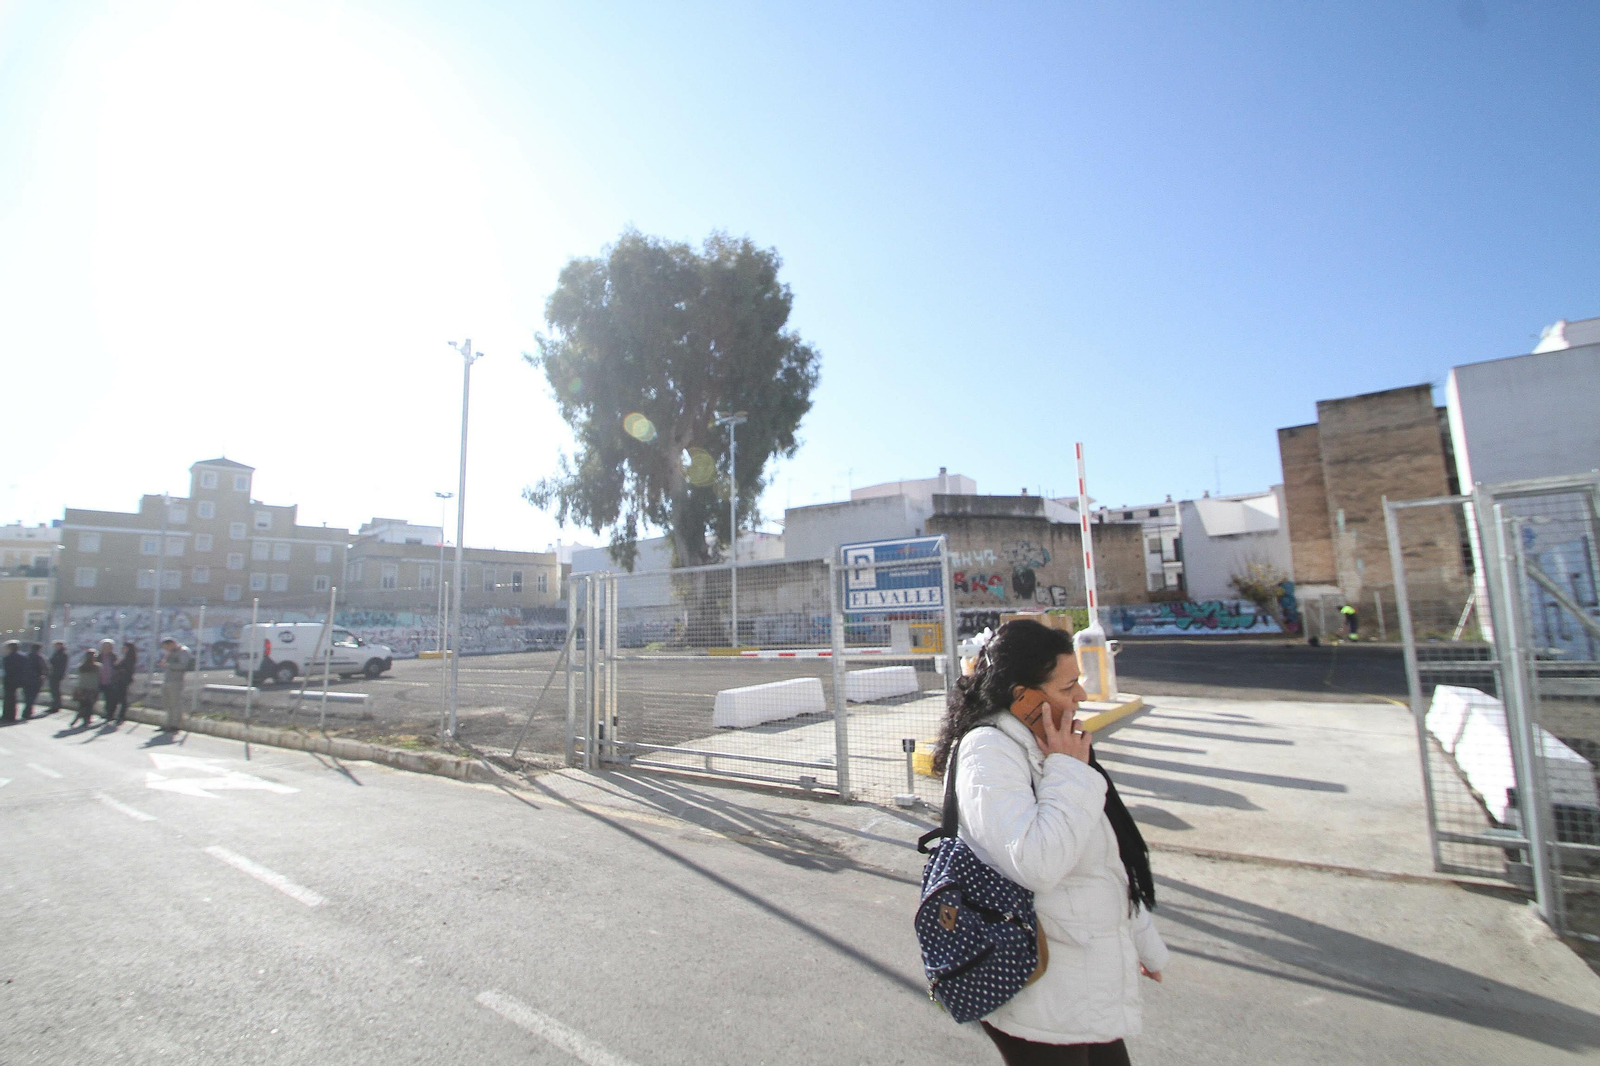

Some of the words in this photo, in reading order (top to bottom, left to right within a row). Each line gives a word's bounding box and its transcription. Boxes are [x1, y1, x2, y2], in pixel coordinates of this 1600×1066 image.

[854, 555, 871, 580] P
[852, 593, 872, 606] EL
[879, 589, 939, 604] VALLE
